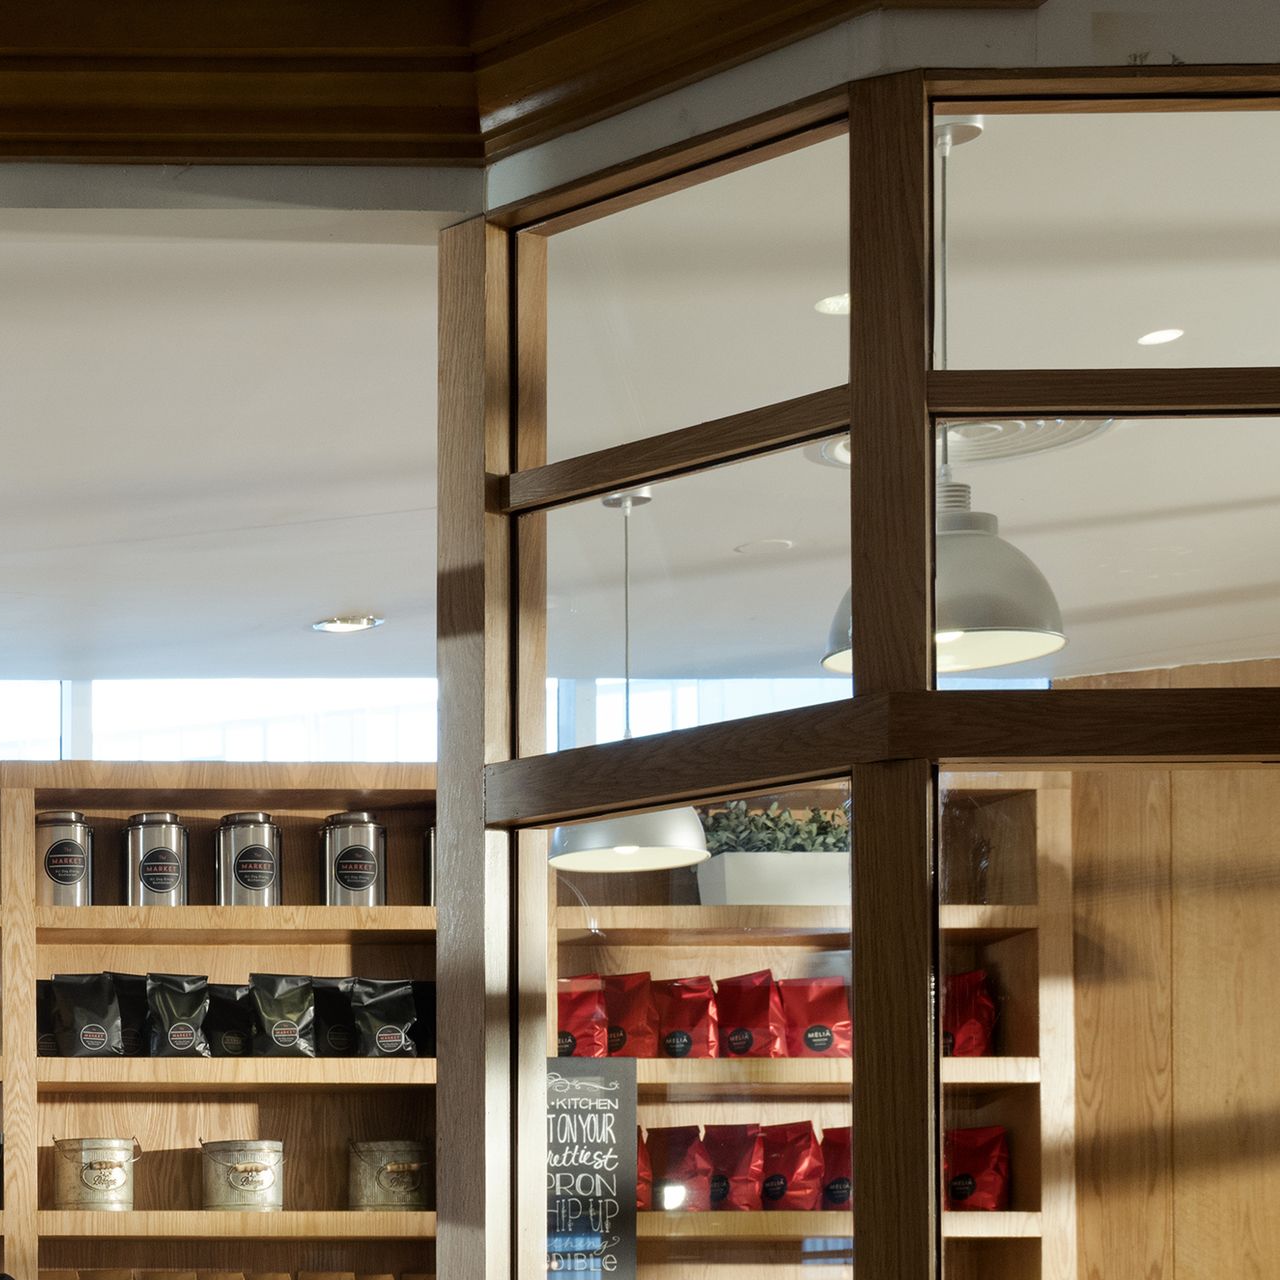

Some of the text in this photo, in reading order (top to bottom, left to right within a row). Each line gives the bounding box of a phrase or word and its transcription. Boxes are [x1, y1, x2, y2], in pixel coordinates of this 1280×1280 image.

[556, 1098, 619, 1110] KITCHEN
[557, 1113, 577, 1143] ON
[578, 1113, 616, 1144] YOUR
[547, 1145, 619, 1171] rettiest
[547, 1172, 617, 1196] PRON
[589, 1198, 619, 1233] UP
